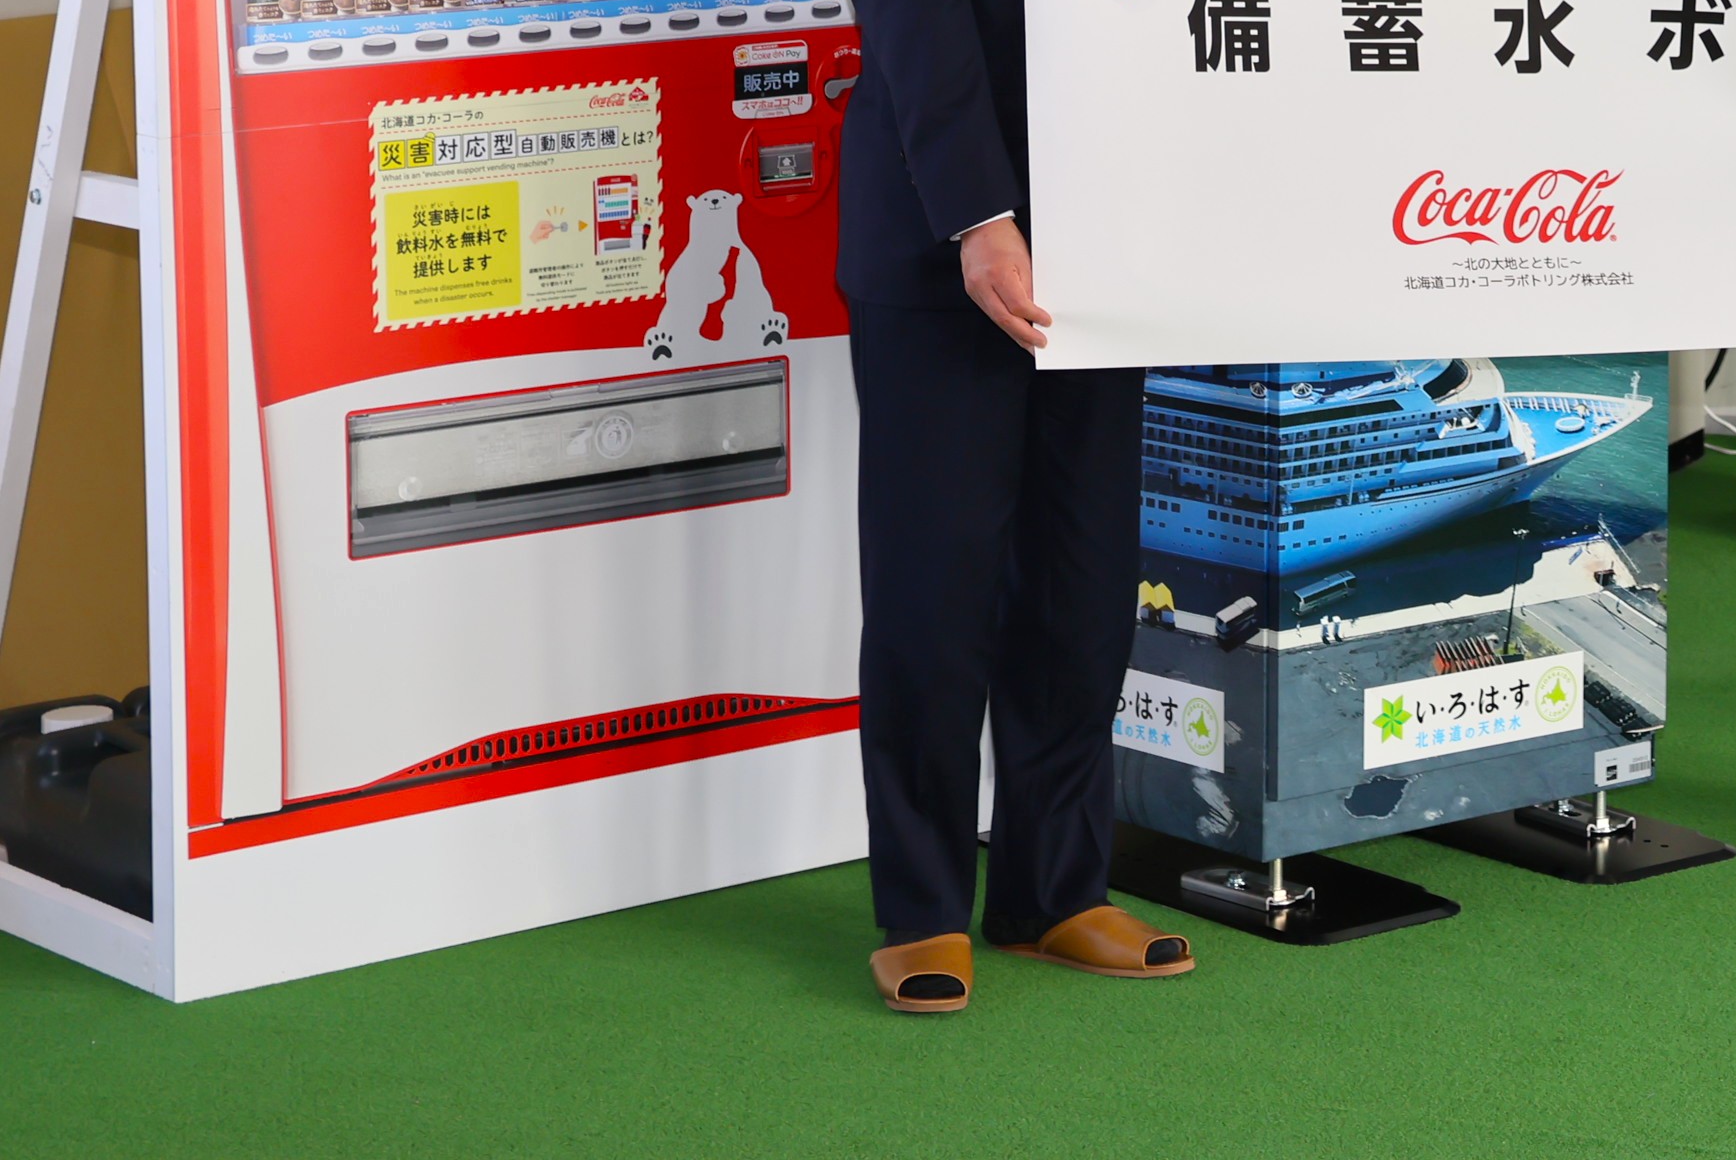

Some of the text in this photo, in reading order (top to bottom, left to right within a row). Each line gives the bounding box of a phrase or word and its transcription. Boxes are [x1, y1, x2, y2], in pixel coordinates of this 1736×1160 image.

[786, 49, 800, 59] Pay
[744, 70, 799, 92] 販売中
[589, 92, 626, 109] Coca-Cola
[381, 110, 484, 128] 北海道コカ・コーラの
[457, 165, 485, 175] support
[487, 162, 515, 173] vending
[412, 205, 491, 228] 災害時には
[1392, 169, 1624, 245] Coca-Cola
[396, 229, 507, 254] 飲料水を無料で
[414, 254, 492, 278] 提供します
[1404, 272, 1634, 290] 北海道コカ・コーラボトリング株式会社
[1415, 715, 1521, 748] 北海道の天然水
